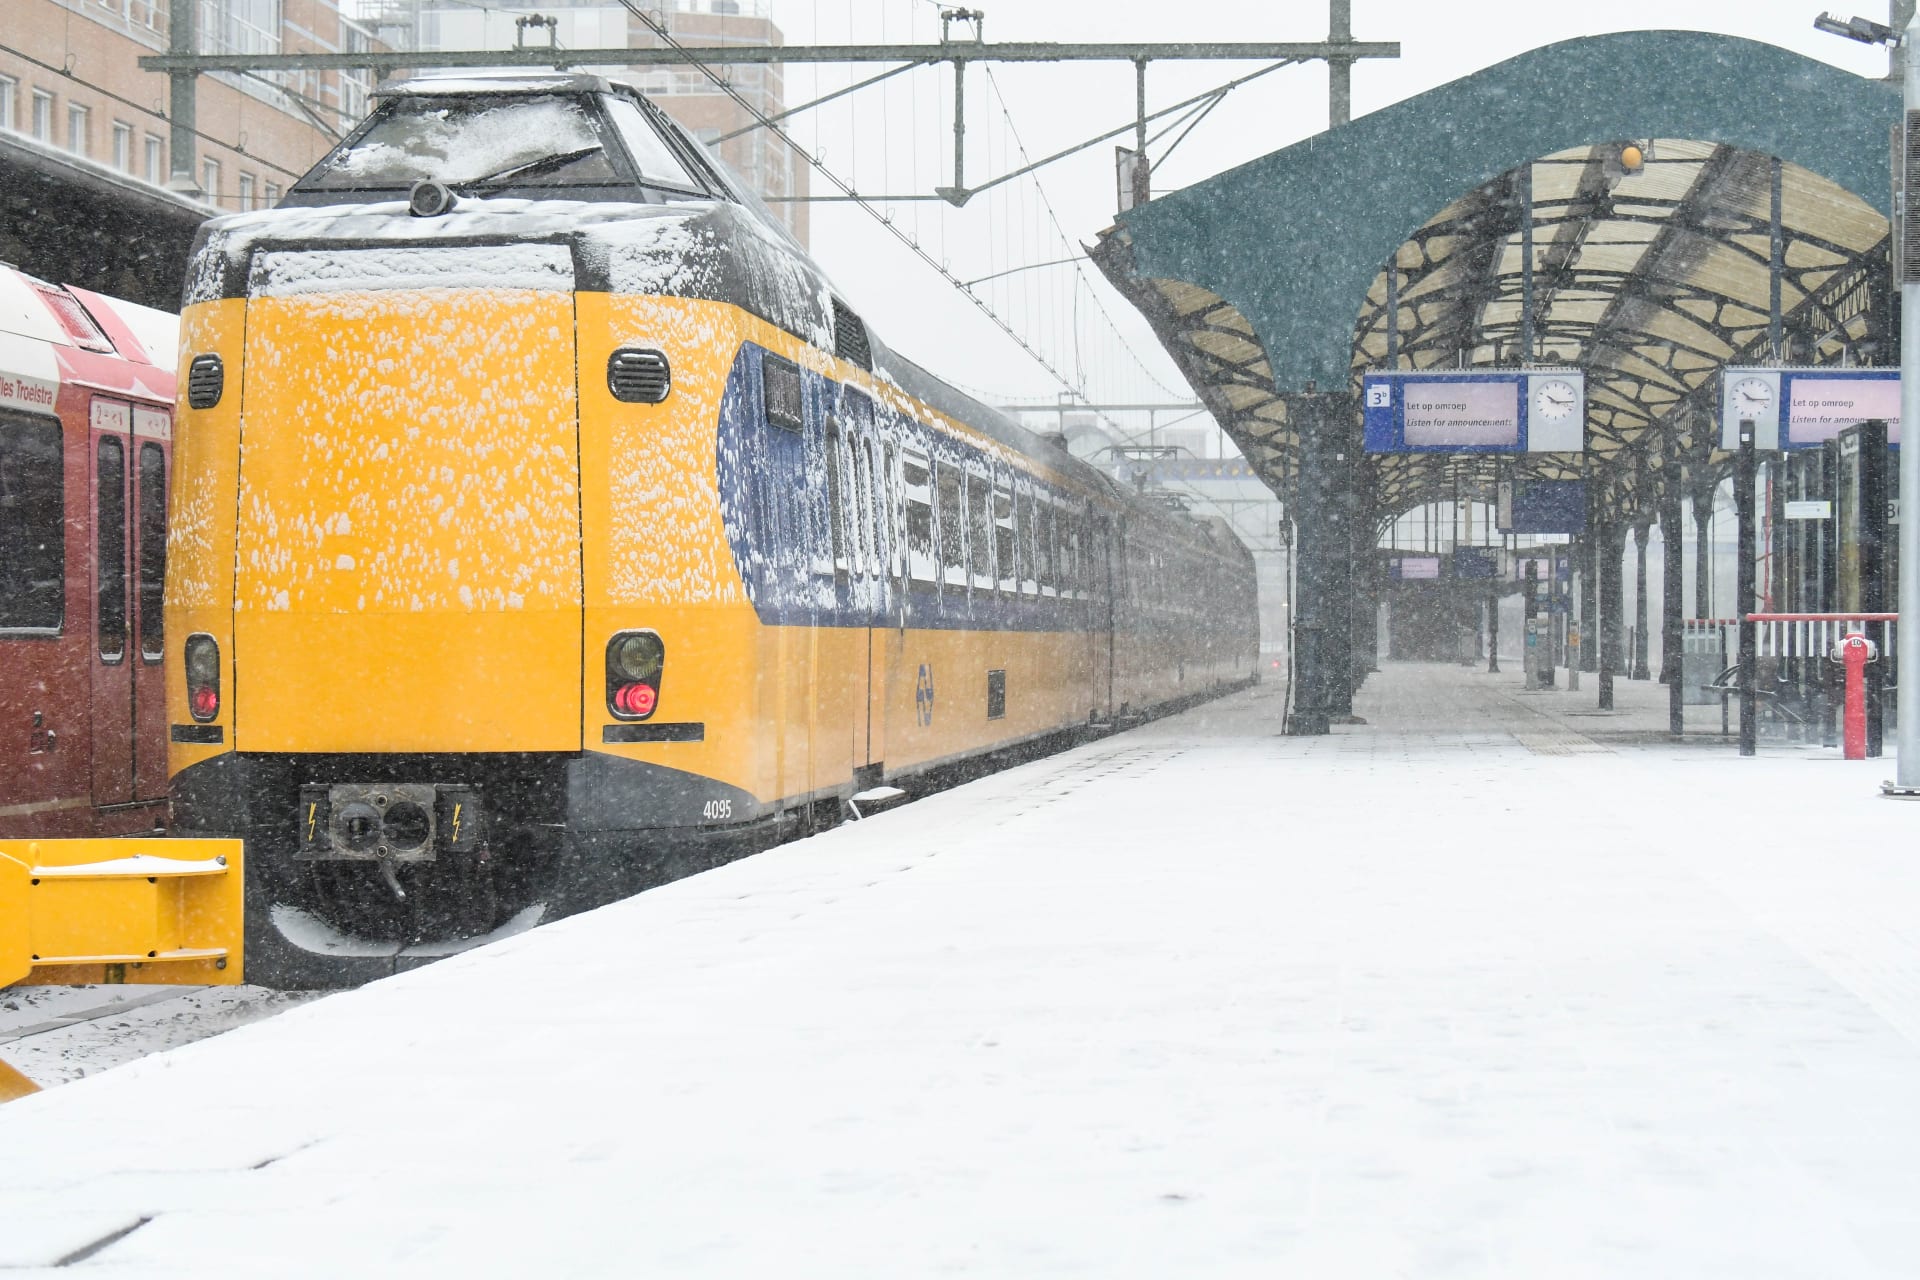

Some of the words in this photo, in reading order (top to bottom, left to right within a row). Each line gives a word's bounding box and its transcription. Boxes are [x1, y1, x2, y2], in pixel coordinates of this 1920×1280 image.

[0, 376, 14, 398] les
[16, 379, 53, 405] Troelstra
[1407, 402, 1420, 410] Let
[1422, 403, 1433, 412] op
[1435, 403, 1467, 412] omroep
[1793, 399, 1806, 407] Let
[1808, 400, 1819, 408] op
[1821, 400, 1854, 409] omroep
[1406, 419, 1431, 427] Listen
[1433, 418, 1446, 427] for
[1792, 416, 1817, 424] Listen
[1819, 416, 1832, 424] for
[1833, 416, 1900, 425] announnts
[703, 799, 732, 819] 4095
